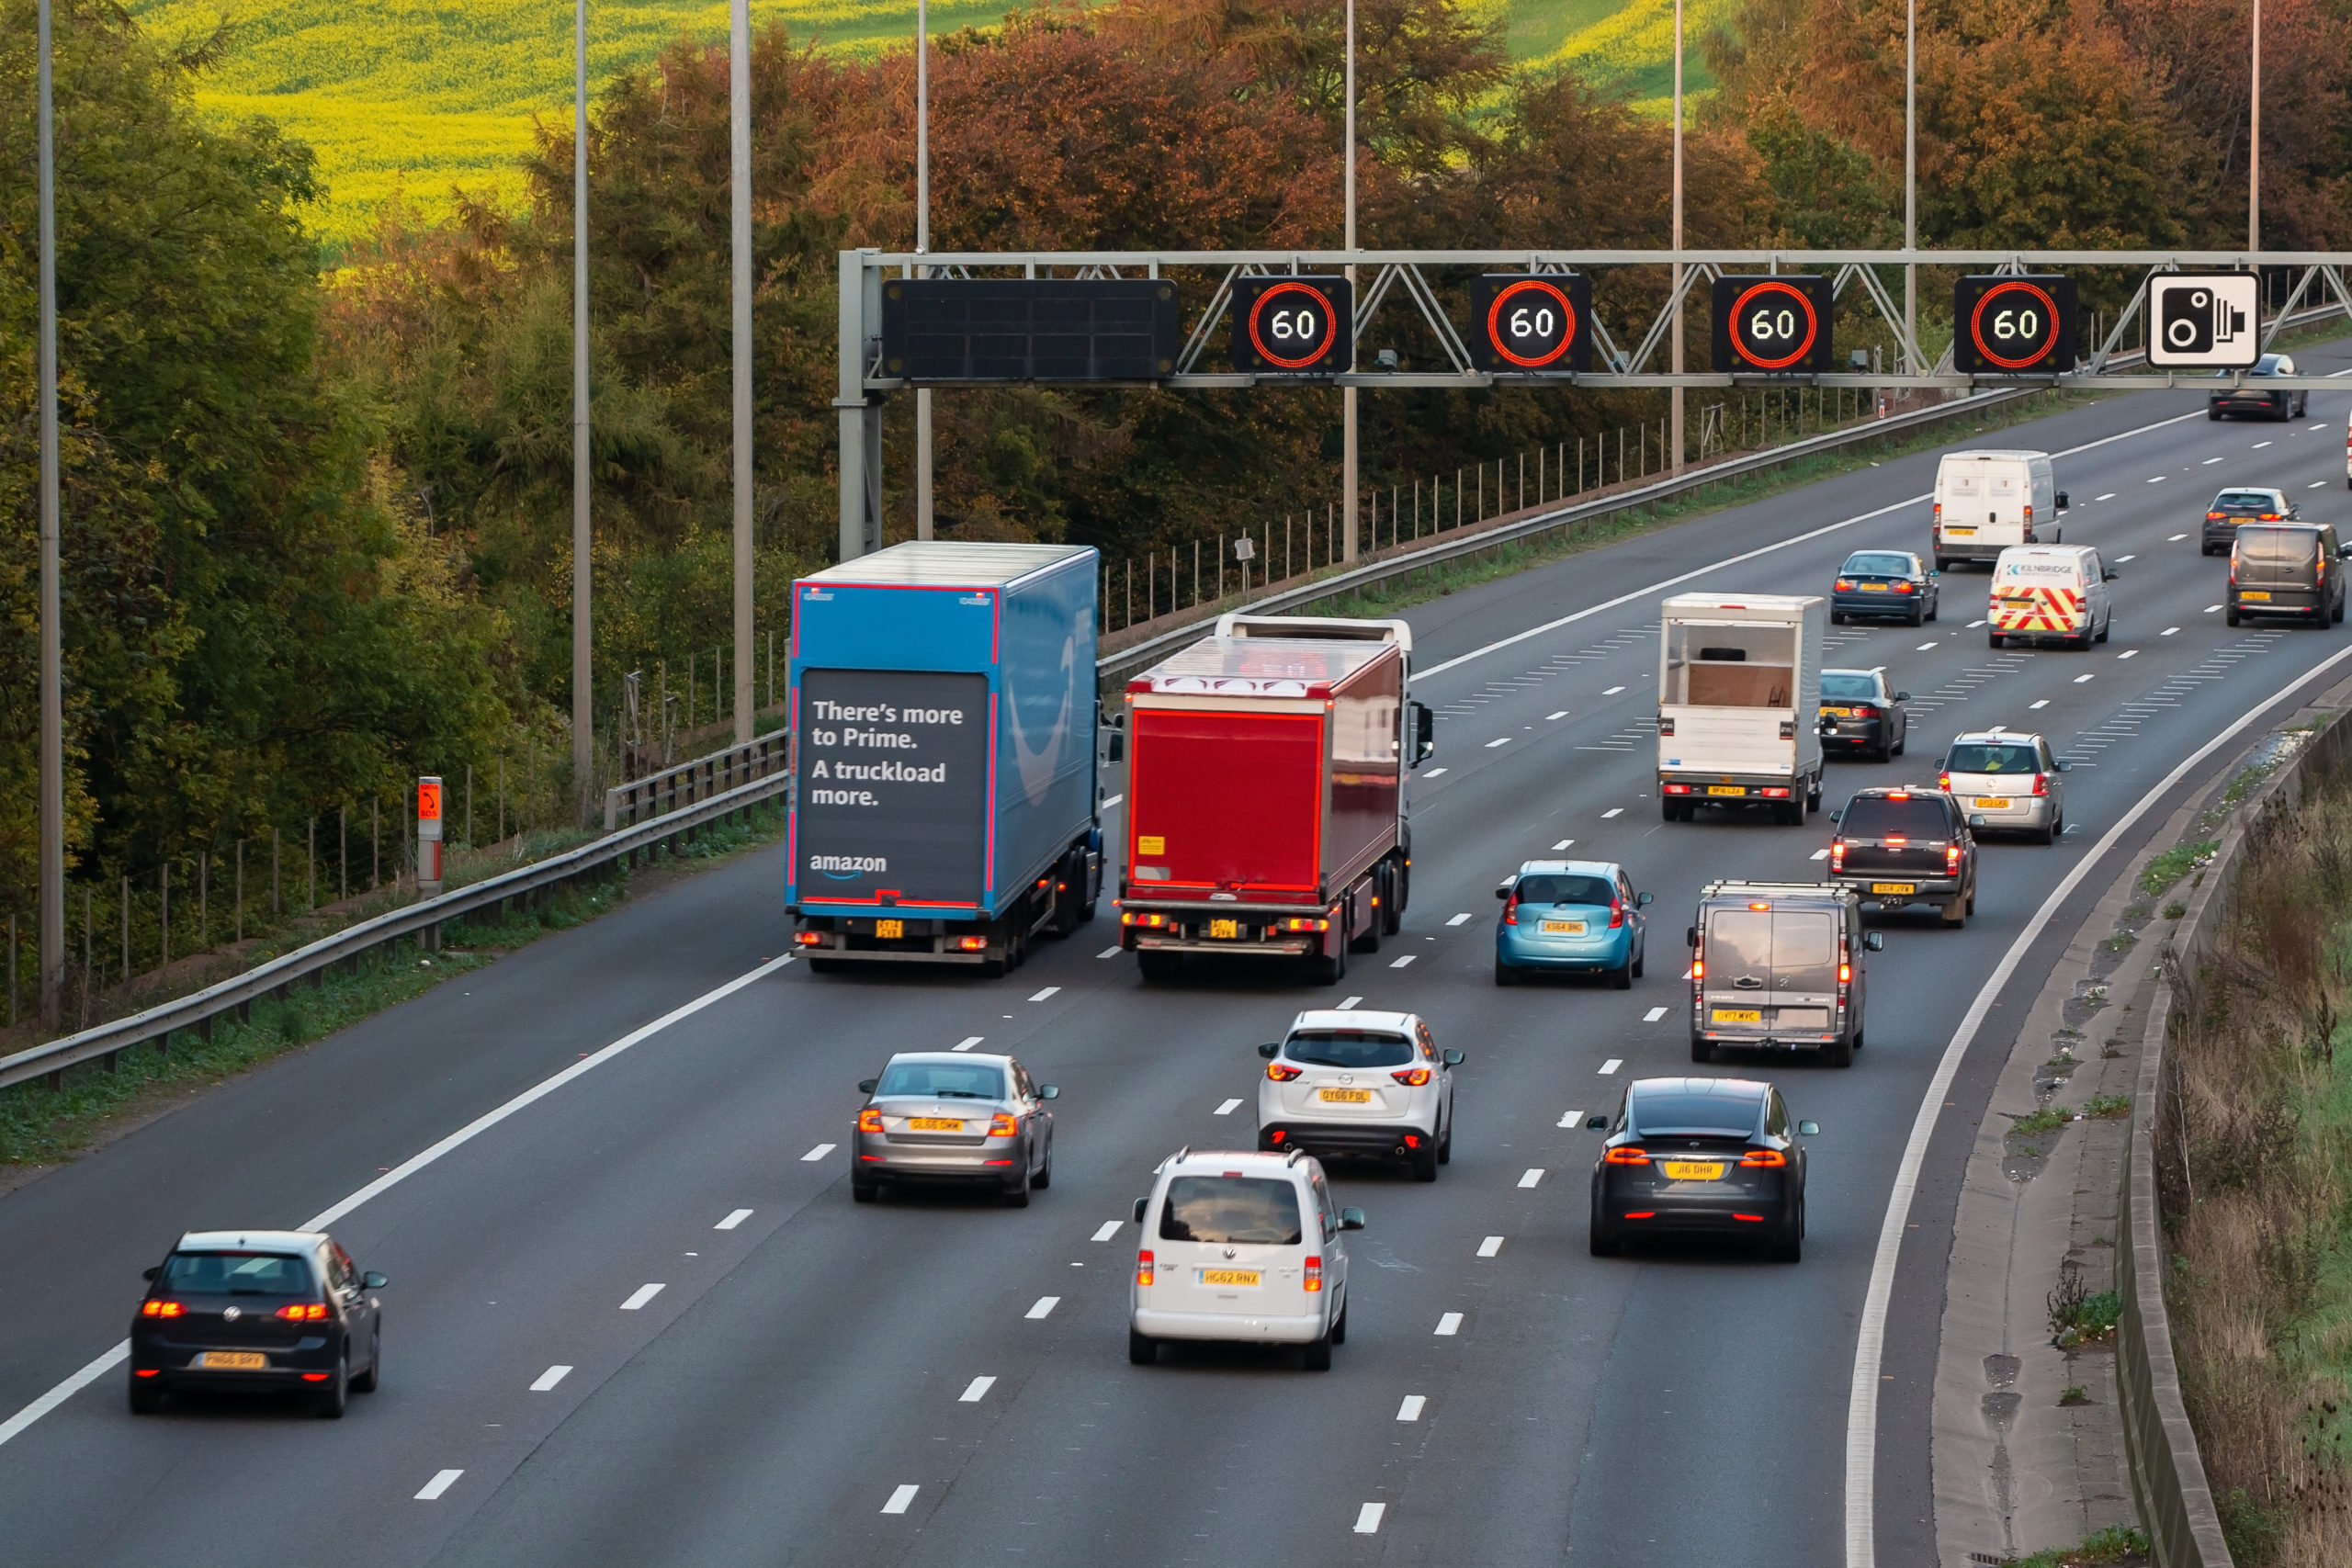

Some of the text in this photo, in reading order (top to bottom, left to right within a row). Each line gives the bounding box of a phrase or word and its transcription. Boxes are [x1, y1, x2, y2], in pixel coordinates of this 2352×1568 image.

[1272, 310, 1315, 340] 60
[1510, 308, 1554, 337] 60
[1751, 310, 1794, 340] 60
[1994, 310, 2038, 339] 60
[2020, 564, 2074, 574] KILNBRIDGE
[812, 700, 963, 725] There's more
[811, 727, 918, 749] to Prime.
[811, 760, 945, 783] A truckload
[811, 789, 879, 807] more.
[420, 809, 437, 818] SOS
[809, 854, 887, 873] amazon
